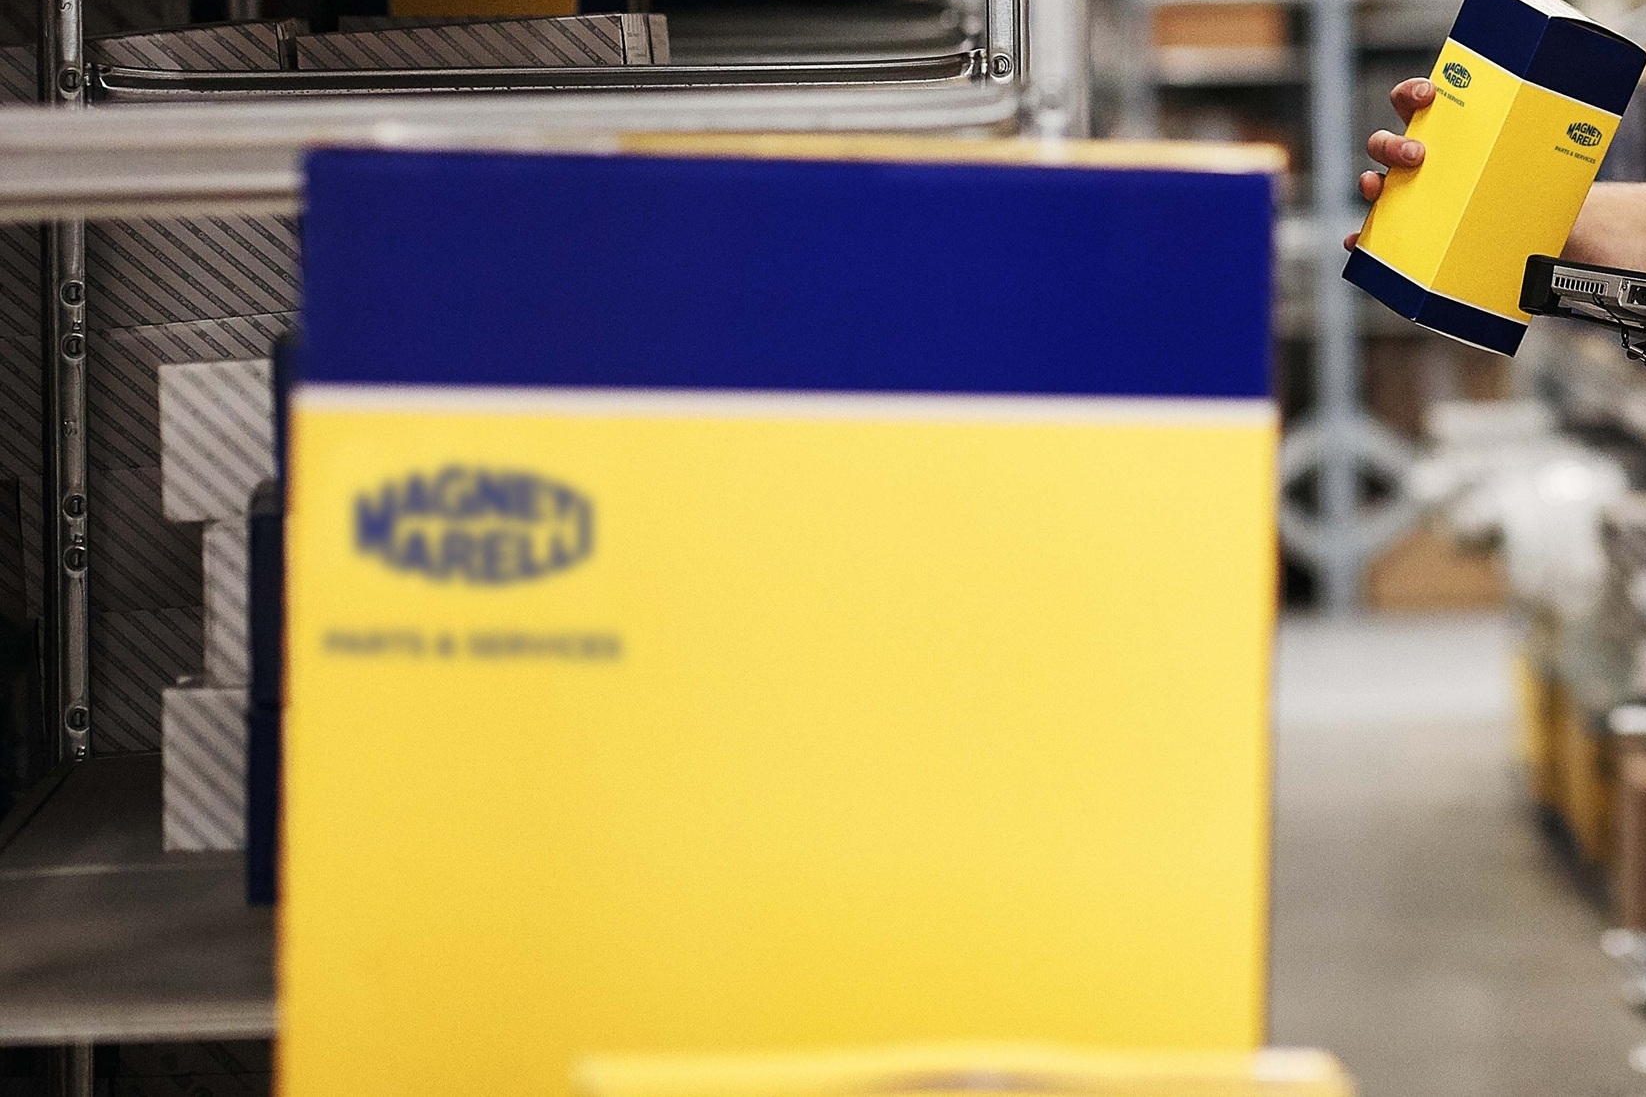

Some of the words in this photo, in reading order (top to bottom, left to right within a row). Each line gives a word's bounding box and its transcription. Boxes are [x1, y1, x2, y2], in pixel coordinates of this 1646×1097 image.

[1442, 62, 1472, 81] MAGNETI
[1442, 70, 1472, 89] MARELLI
[1566, 122, 1603, 139] MAGNETI
[1566, 129, 1603, 147] MARELLI
[1554, 146, 1571, 157] PARTS
[1574, 152, 1596, 165] SERVICES
